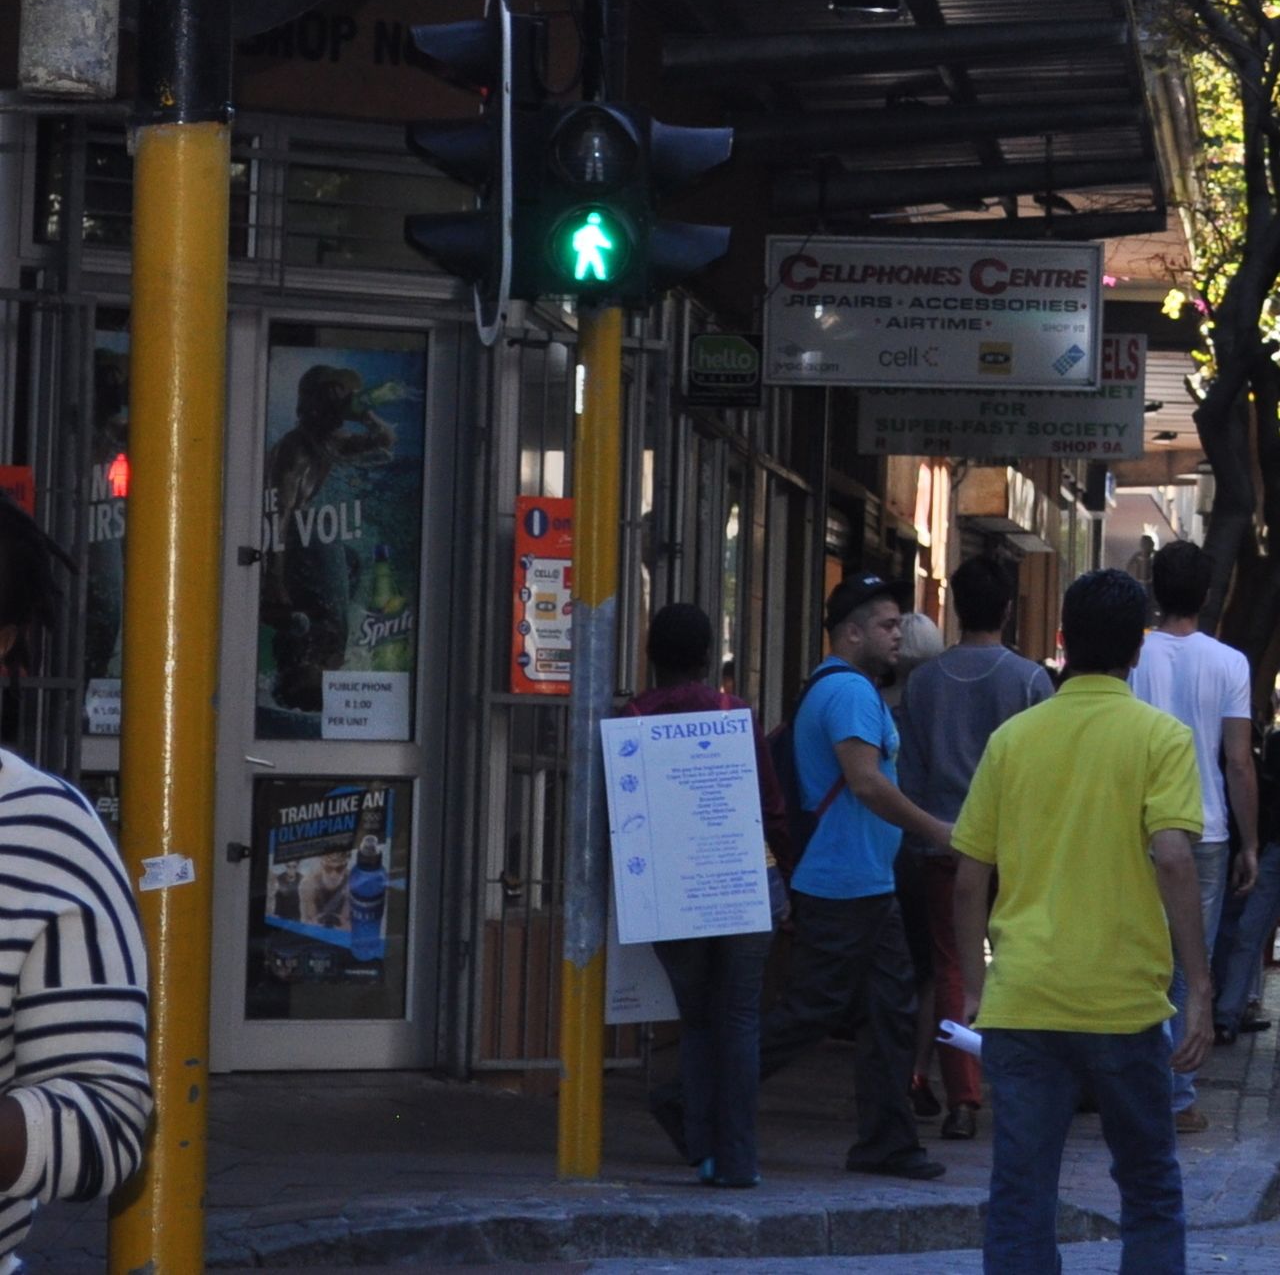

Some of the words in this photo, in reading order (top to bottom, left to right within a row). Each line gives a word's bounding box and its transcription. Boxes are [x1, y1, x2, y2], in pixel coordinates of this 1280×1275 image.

[780, 254, 962, 291] CELLPHONES
[969, 257, 1088, 295] CENTRE
[788, 294, 893, 310] REPAIRS
[909, 297, 1078, 313] ACCESSORIES
[698, 345, 753, 370] hello
[980, 402, 1026, 416] FOR
[875, 418, 1018, 436] SUPER-FAST
[1027, 421, 1129, 438] SOCIETY
[1051, 440, 1097, 453] SHOP
[295, 499, 362, 548] VOL!
[328, 682, 360, 692] PUBLIC
[361, 682, 393, 692] PHONE
[328, 716, 345, 726] PER
[347, 716, 369, 726] UNIT
[650, 718, 749, 741] STARDUST
[279, 798, 327, 825] TRAIN
[327, 794, 359, 819] LIKE
[362, 790, 386, 810] AN
[278, 813, 357, 844] OLYMPIAN
